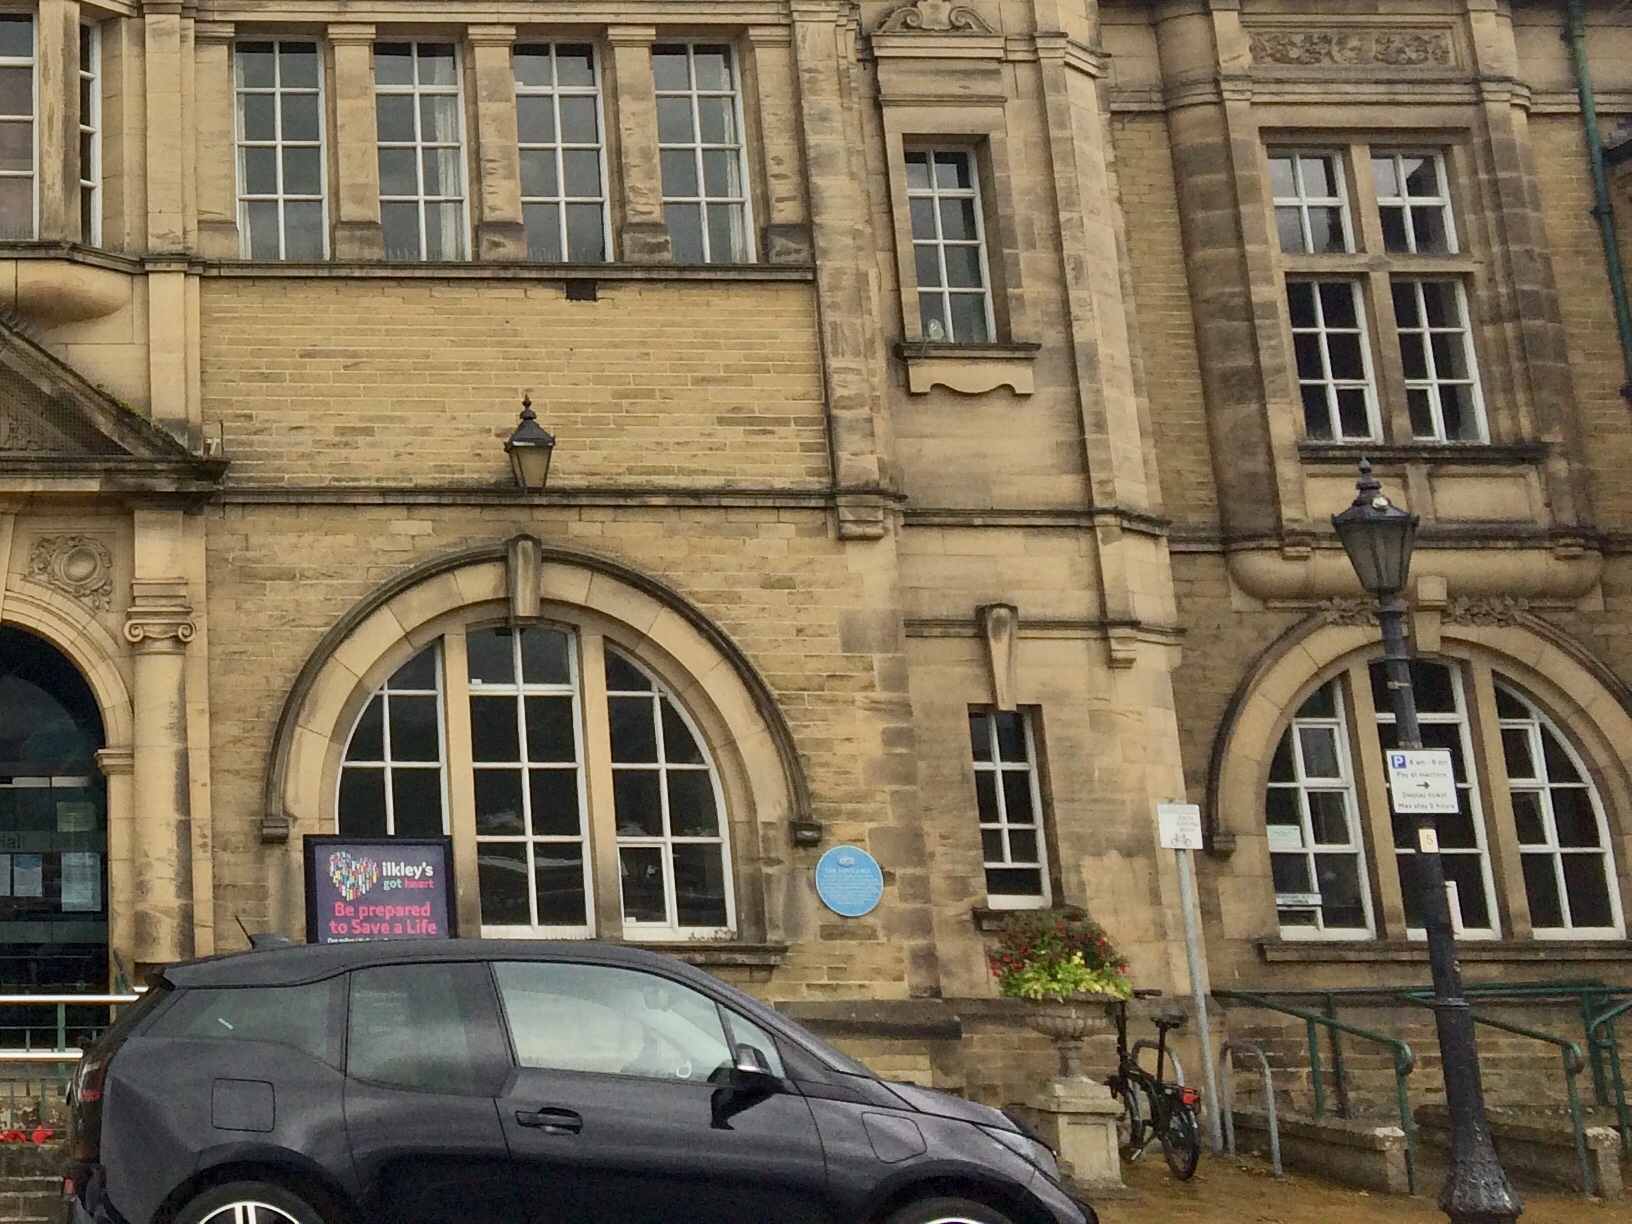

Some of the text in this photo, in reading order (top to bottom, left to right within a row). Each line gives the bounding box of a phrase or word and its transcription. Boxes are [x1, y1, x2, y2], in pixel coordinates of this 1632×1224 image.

[1426, 834, 1434, 845] 5
[382, 862, 433, 879] ilkley's
[383, 878, 434, 890] got heart
[334, 901, 430, 920] Be prepared
[330, 919, 437, 934] to Save a Life
